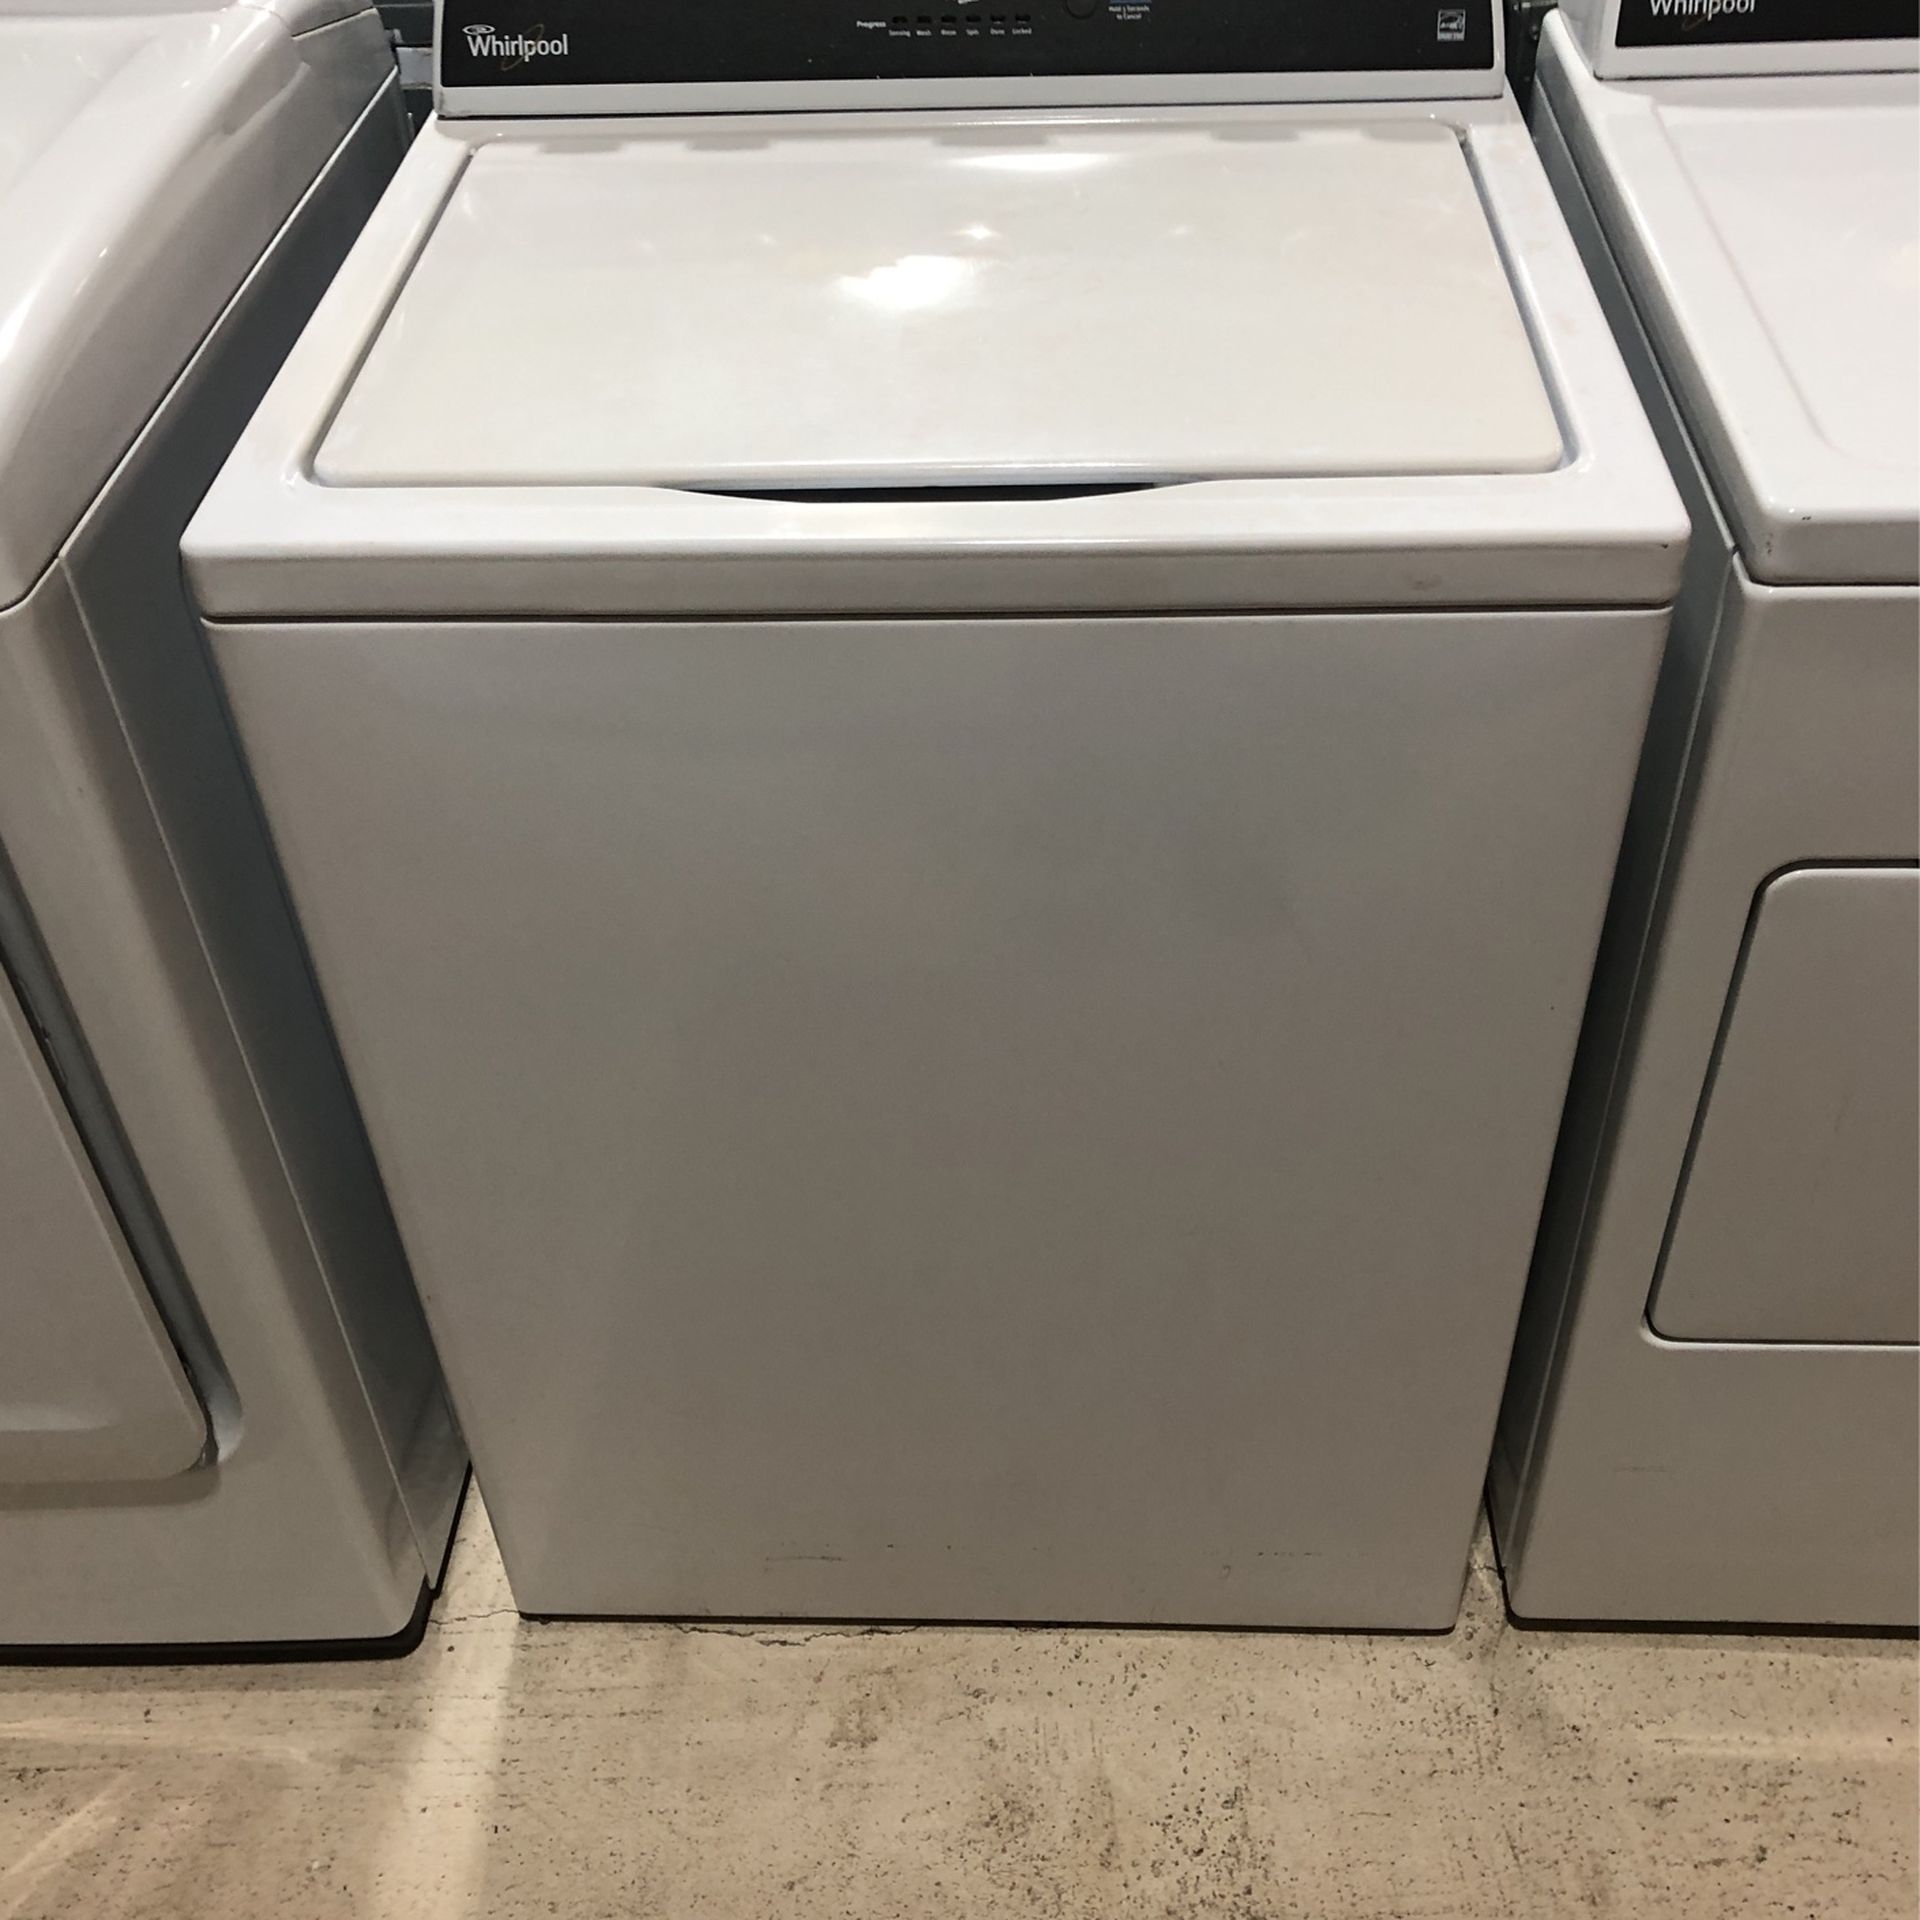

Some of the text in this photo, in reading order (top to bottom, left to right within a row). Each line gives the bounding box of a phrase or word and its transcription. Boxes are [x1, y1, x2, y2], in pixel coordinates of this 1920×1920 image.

[856, 20, 887, 30] Progress
[1011, 27, 1032, 35] Locked
[466, 33, 569, 62] Whirlpool
